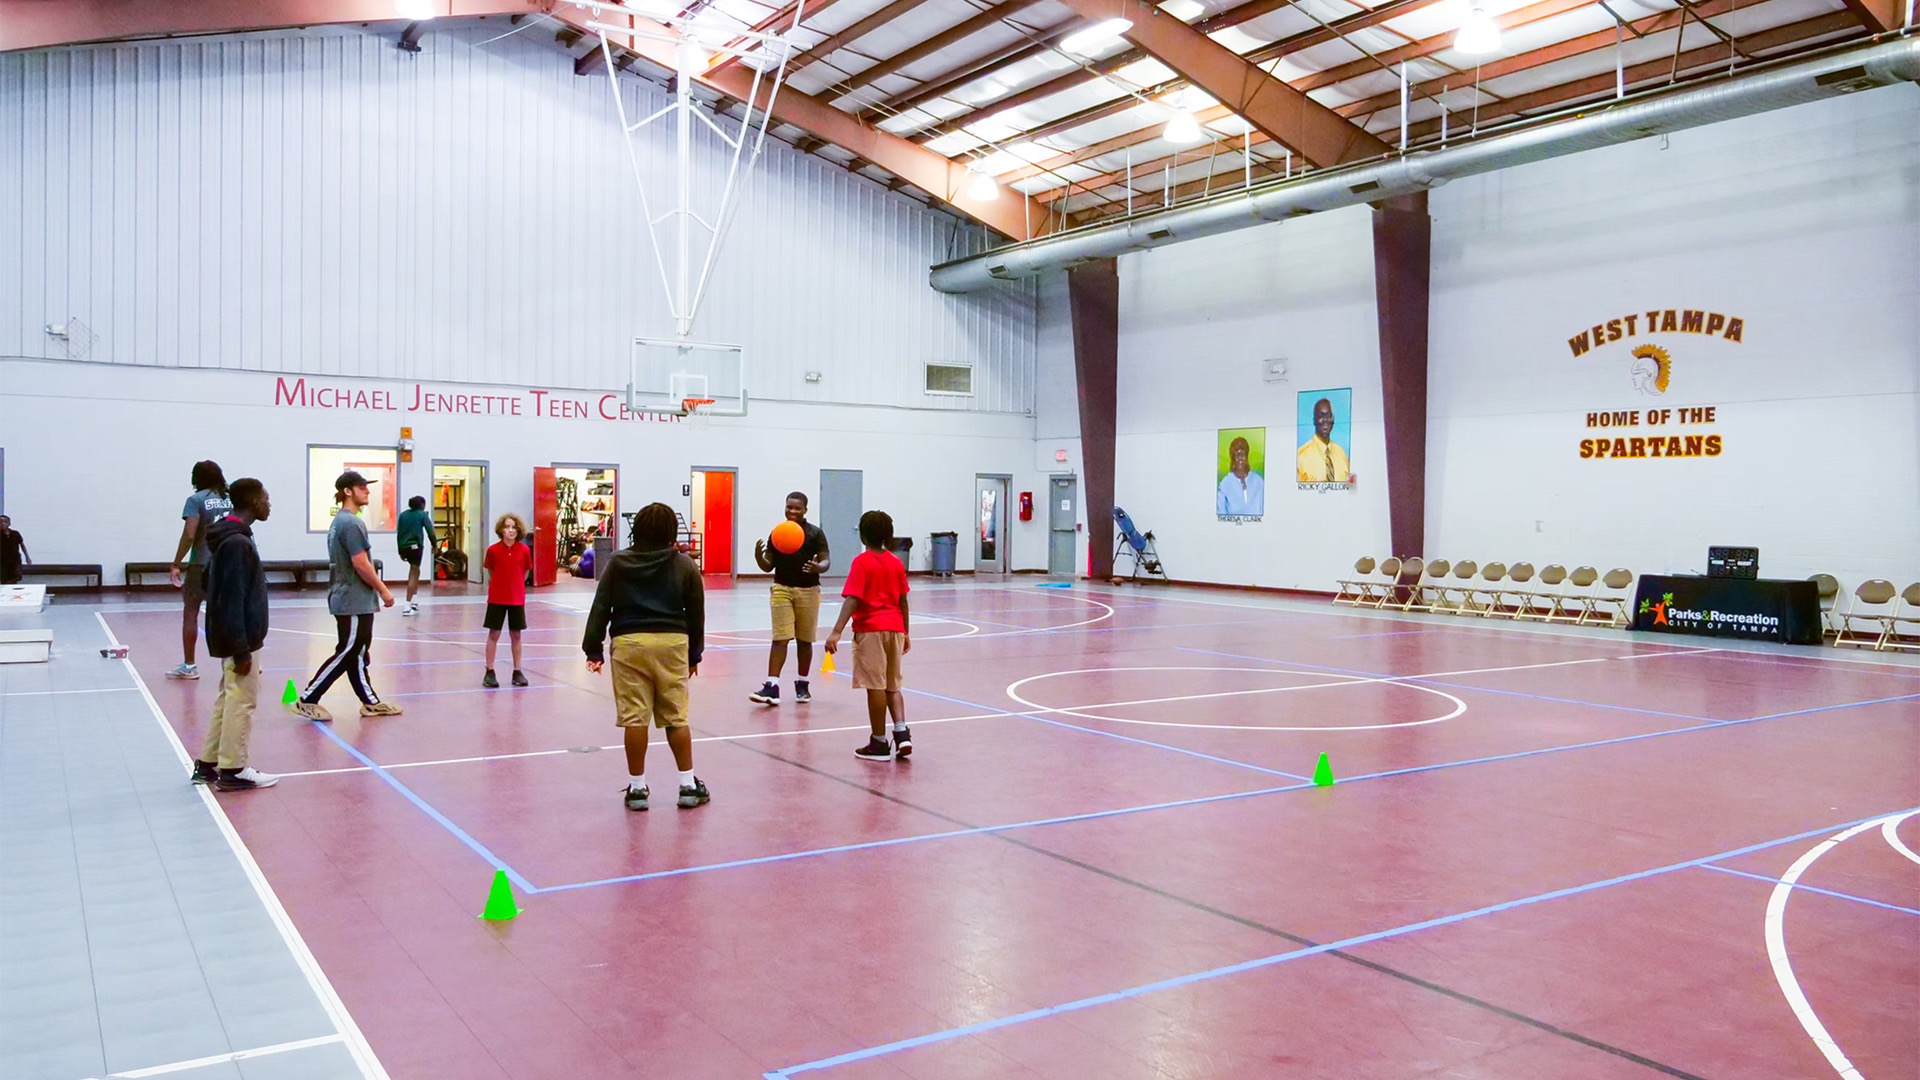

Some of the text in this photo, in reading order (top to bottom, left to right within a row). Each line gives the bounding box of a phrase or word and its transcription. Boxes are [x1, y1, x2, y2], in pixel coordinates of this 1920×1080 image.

[1567, 308, 1745, 358] WEST TAMPA
[275, 377, 397, 411] MICHAEL
[1586, 407, 1716, 428] HOME OF THE
[1579, 434, 1722, 459] SPARTANS
[1297, 482, 1320, 491] RICKY
[1668, 619, 1698, 628] CITY
[1733, 624, 1778, 634] TAMPA
